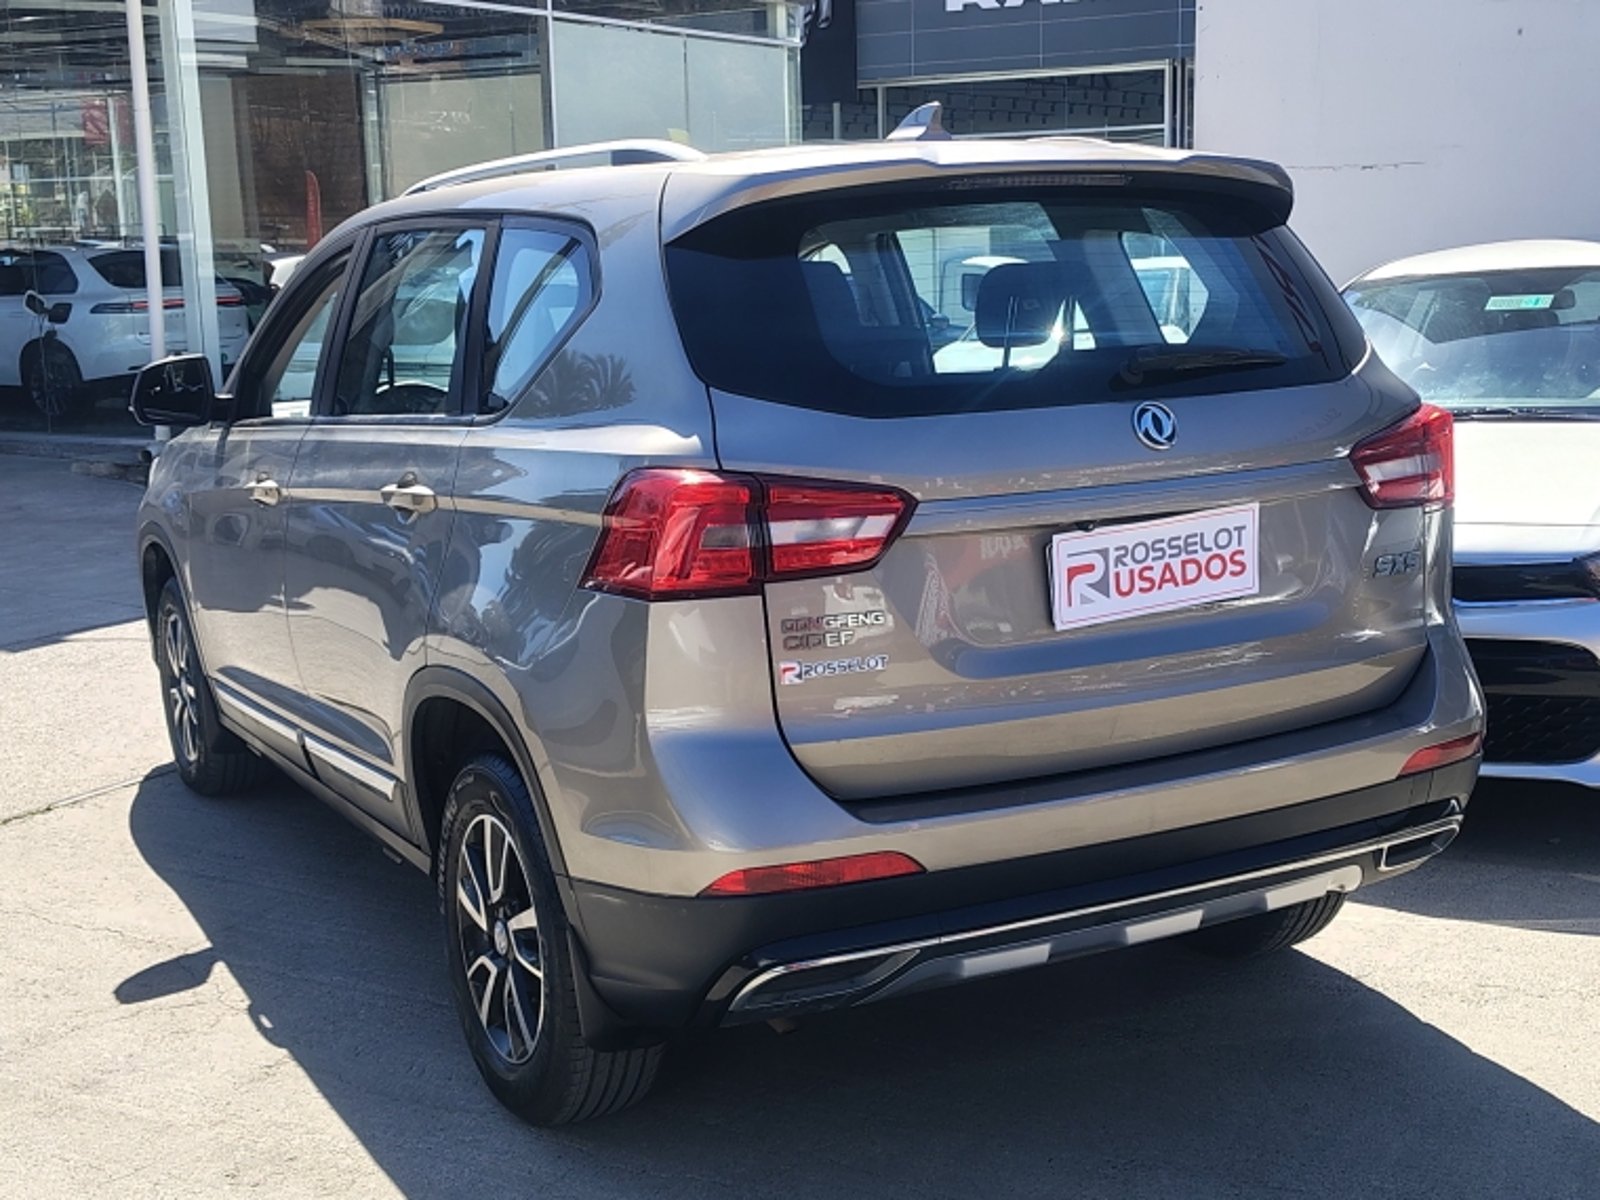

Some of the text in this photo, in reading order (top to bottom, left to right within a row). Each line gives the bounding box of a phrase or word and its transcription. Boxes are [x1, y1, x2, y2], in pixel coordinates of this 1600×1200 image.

[1114, 526, 1247, 568] ROSSELOT
[1114, 549, 1248, 598] USADOS
[803, 656, 888, 678] ROSSELOT
